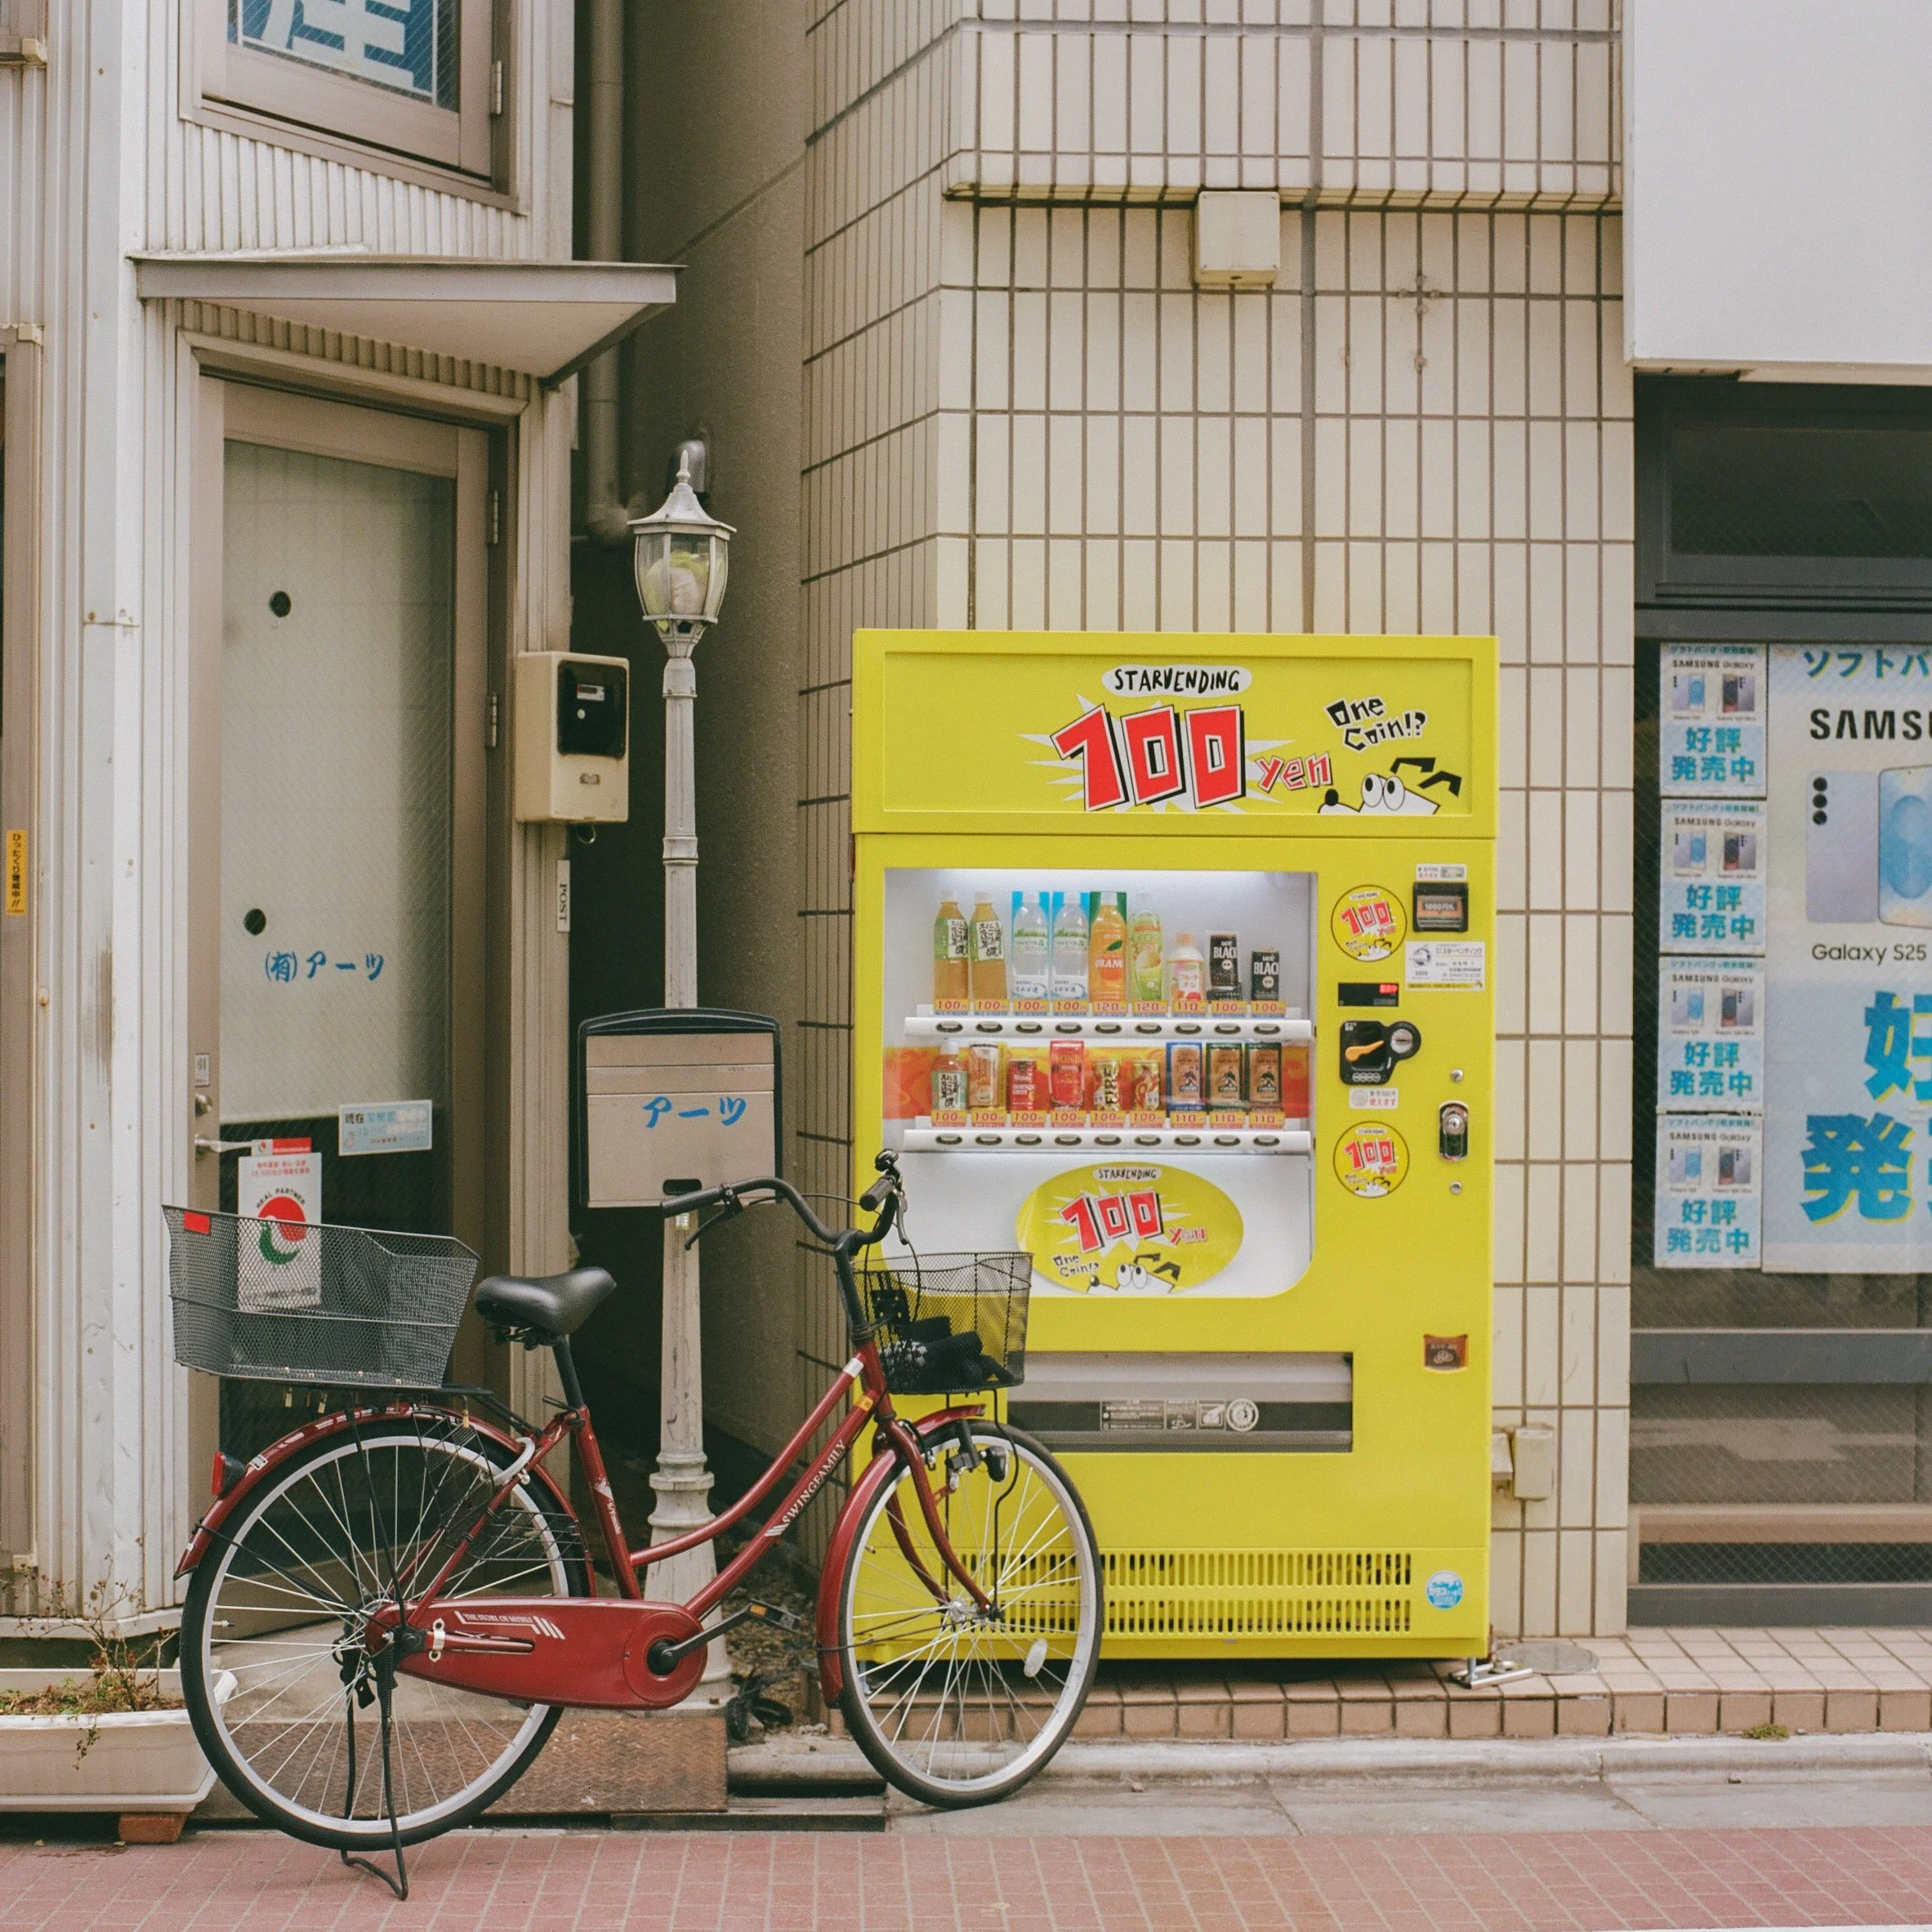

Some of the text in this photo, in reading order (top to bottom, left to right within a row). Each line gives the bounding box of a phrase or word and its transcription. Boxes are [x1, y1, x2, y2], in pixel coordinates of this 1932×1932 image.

[1114, 668, 1240, 694] STARVENDING
[1325, 696, 1385, 727] One
[1810, 709, 1932, 740] SAMS
[1685, 726, 1742, 755] 好評
[1050, 703, 1333, 812] 100 yen
[1671, 755, 1756, 783] 発売中
[1686, 884, 1742, 912] 好評
[1340, 900, 1393, 936] 100
[1671, 913, 1756, 942] 発売中
[1812, 944, 1927, 965] Galaxy S25
[1684, 1041, 1741, 1069] 好評
[1669, 1070, 1753, 1097] 発売中
[642, 1095, 747, 1129] アーツ
[1344, 1139, 1395, 1171] 100
[1800, 1113, 1932, 1225] 発
[1098, 1167, 1158, 1180] STARVENDING
[1060, 1188, 1207, 1253] 100 yen
[1681, 1199, 1738, 1225] 好評
[1667, 1228, 1750, 1255] 発売中
[1052, 1254, 1080, 1266] One
